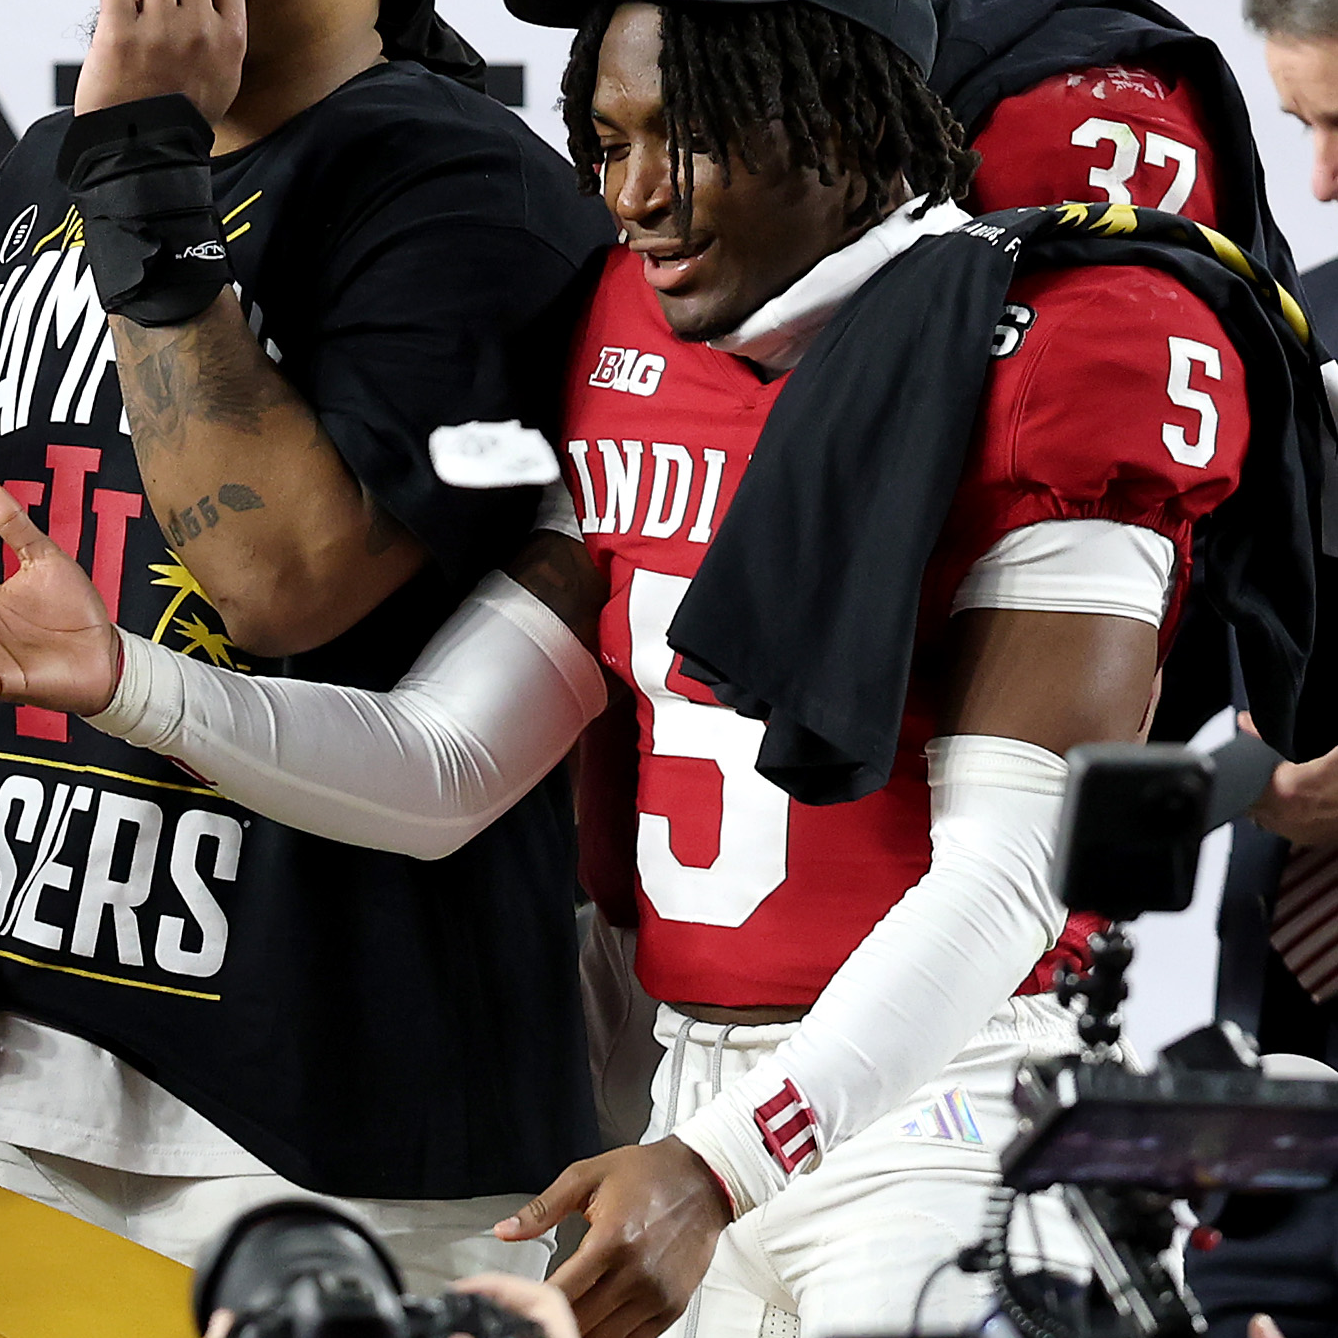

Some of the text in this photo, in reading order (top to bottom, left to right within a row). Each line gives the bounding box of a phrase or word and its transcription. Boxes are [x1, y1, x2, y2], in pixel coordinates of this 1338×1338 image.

[1062, 117, 1197, 215] 37
[1161, 335, 1223, 469] 5
[627, 567, 791, 928] 5
